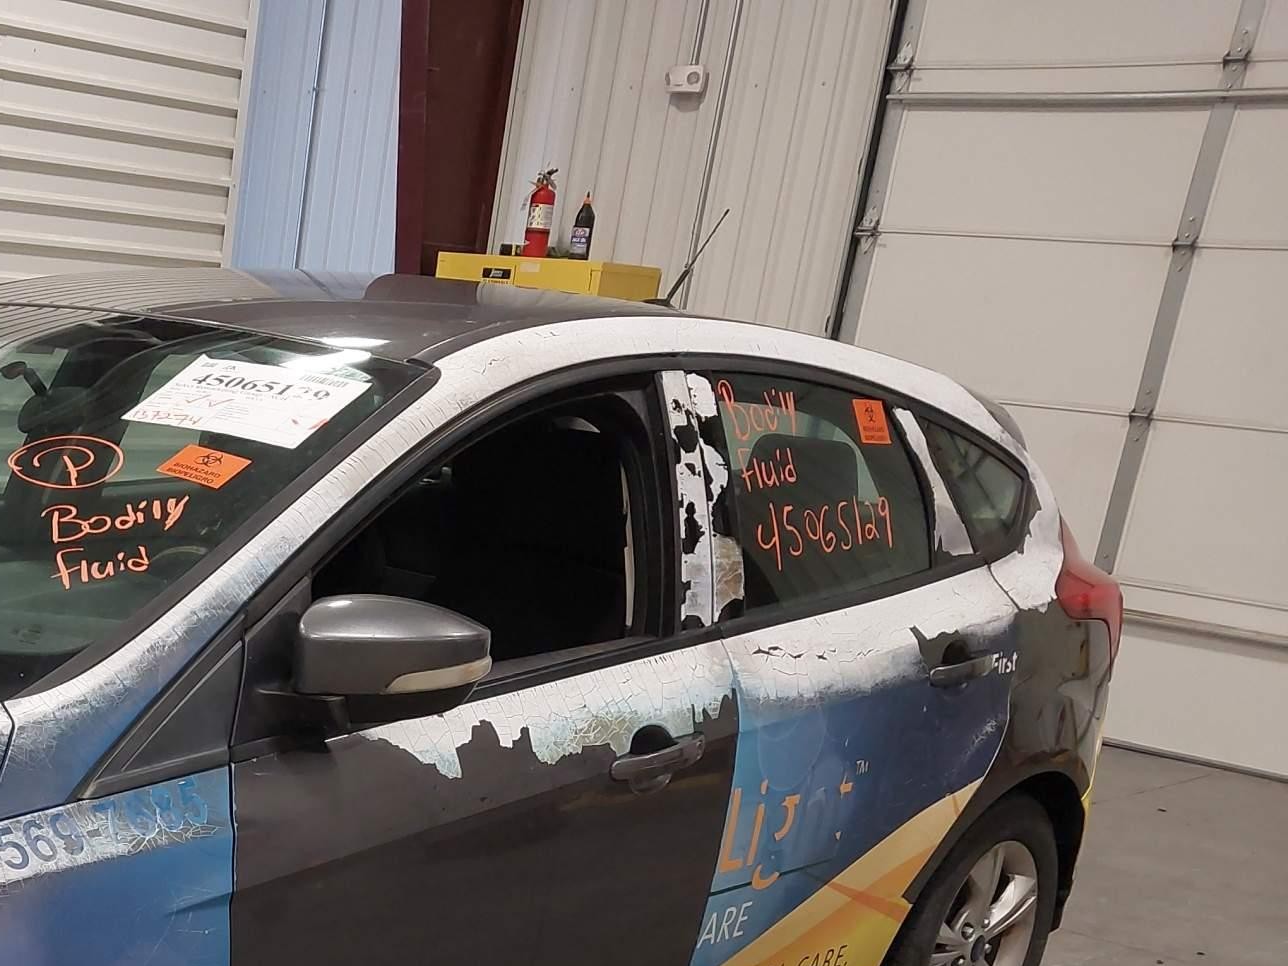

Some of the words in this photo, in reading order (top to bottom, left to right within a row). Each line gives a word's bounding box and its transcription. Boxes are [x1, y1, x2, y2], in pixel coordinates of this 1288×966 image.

[166, 466, 215, 484] BIOPELIGRO
[173, 461, 221, 479] BIOHAZARD
[756, 495, 893, 571] 45065129
[992, 651, 1018, 674] First
